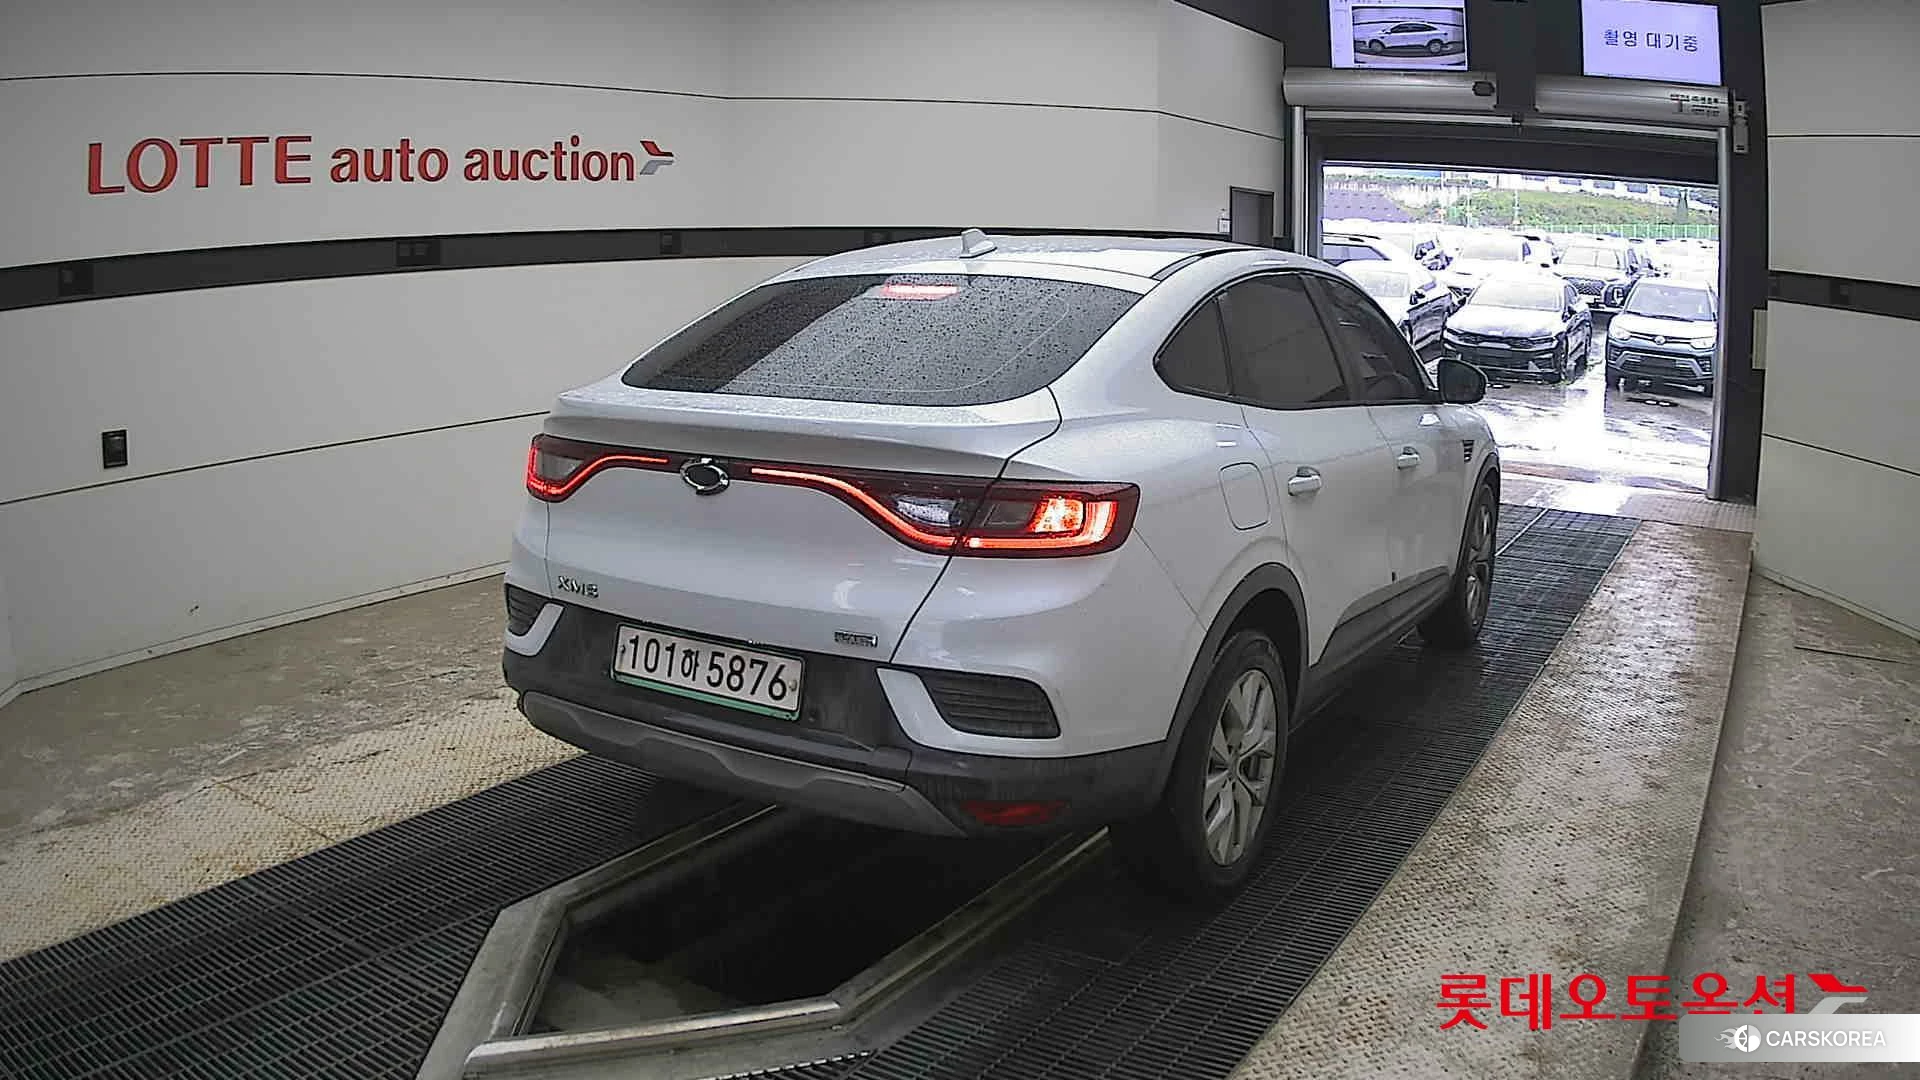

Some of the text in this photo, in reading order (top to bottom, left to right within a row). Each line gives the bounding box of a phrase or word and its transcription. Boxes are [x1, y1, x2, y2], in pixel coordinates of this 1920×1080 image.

[1646, 32, 1698, 52] 대기중
[87, 135, 635, 195] LOTTE auto auction
